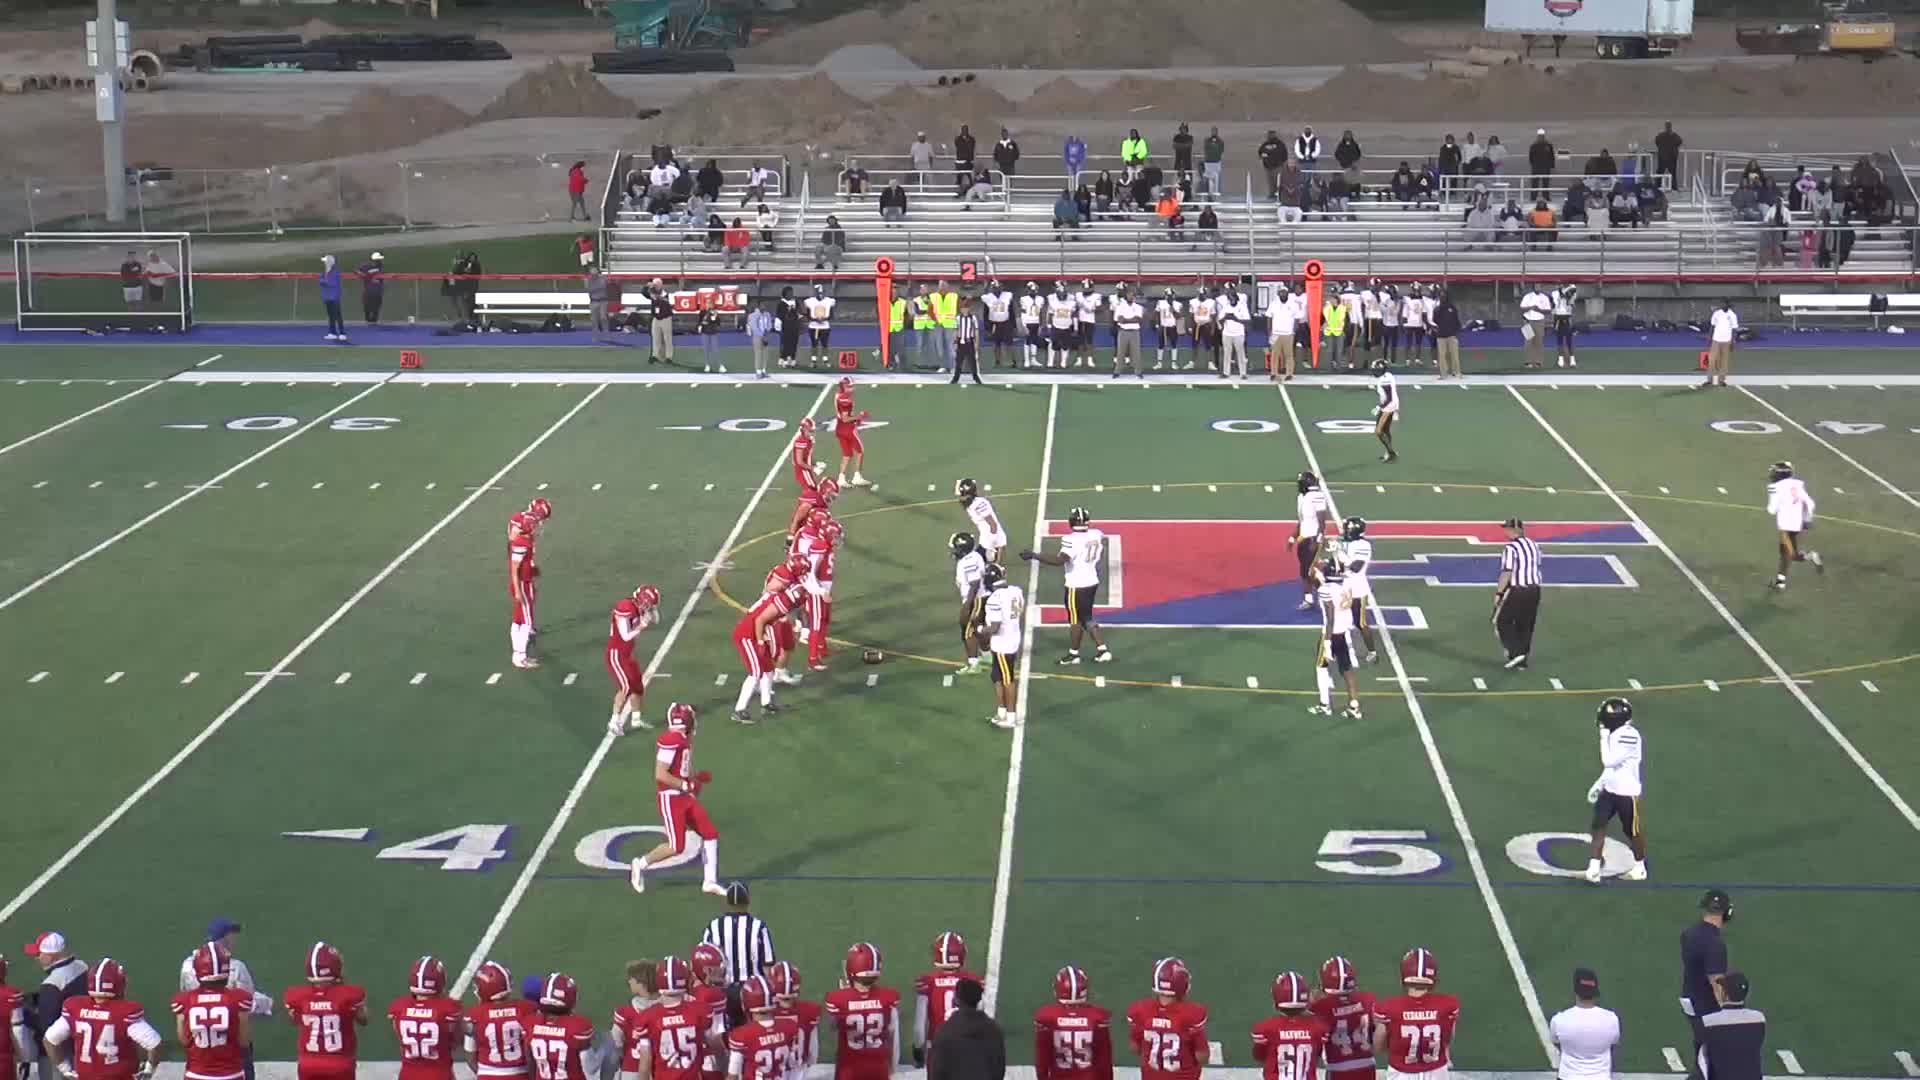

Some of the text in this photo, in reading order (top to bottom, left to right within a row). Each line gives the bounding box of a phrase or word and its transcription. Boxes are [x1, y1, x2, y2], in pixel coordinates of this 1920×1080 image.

[962, 263, 976, 280] 2
[681, 298, 690, 309] G
[401, 352, 416, 366] 30
[840, 352, 856, 367] 40
[80, 1008, 110, 1021] PEARSON
[189, 1006, 229, 1048] 62
[302, 1014, 343, 1052] 78
[845, 1013, 883, 1050] 22
[75, 1020, 119, 1064] 74
[400, 1020, 440, 1060] 52
[484, 1020, 522, 1062] 18
[659, 1025, 697, 1069] 45
[1053, 1030, 1093, 1069] 55
[1143, 1029, 1180, 1072] 72
[1279, 1030, 1312, 1040] MAXWELL
[1331, 1013, 1371, 1056] 44
[1400, 1024, 1442, 1065] 73
[530, 1038, 569, 1080] 87
[1276, 1043, 1313, 1080] 60
